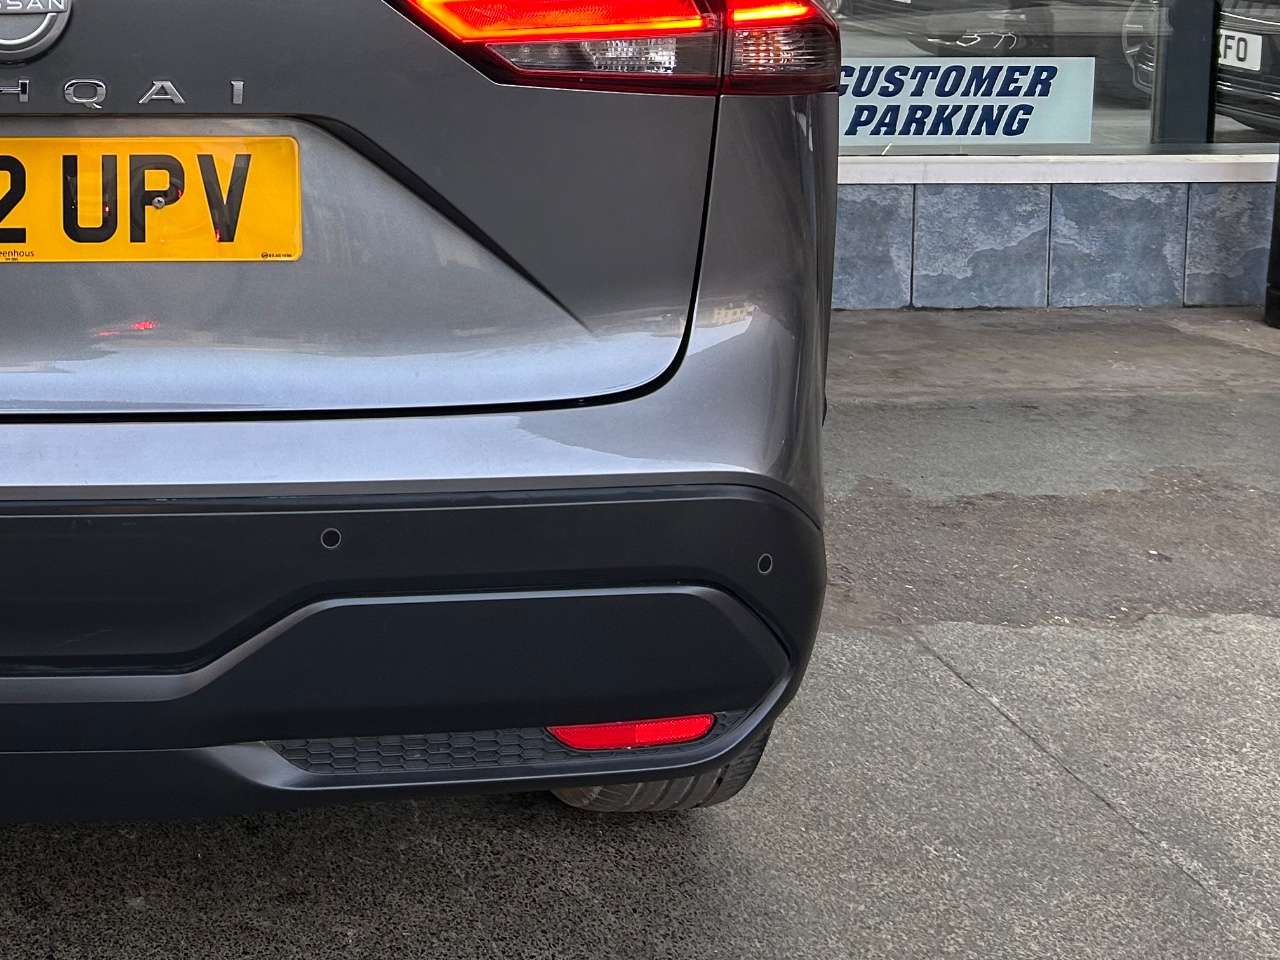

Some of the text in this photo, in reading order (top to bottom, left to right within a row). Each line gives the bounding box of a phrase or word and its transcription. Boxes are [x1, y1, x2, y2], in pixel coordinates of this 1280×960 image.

[1220, 35, 1248, 62] FO
[844, 104, 1035, 136] PARKING
[62, 155, 252, 243] UPV
